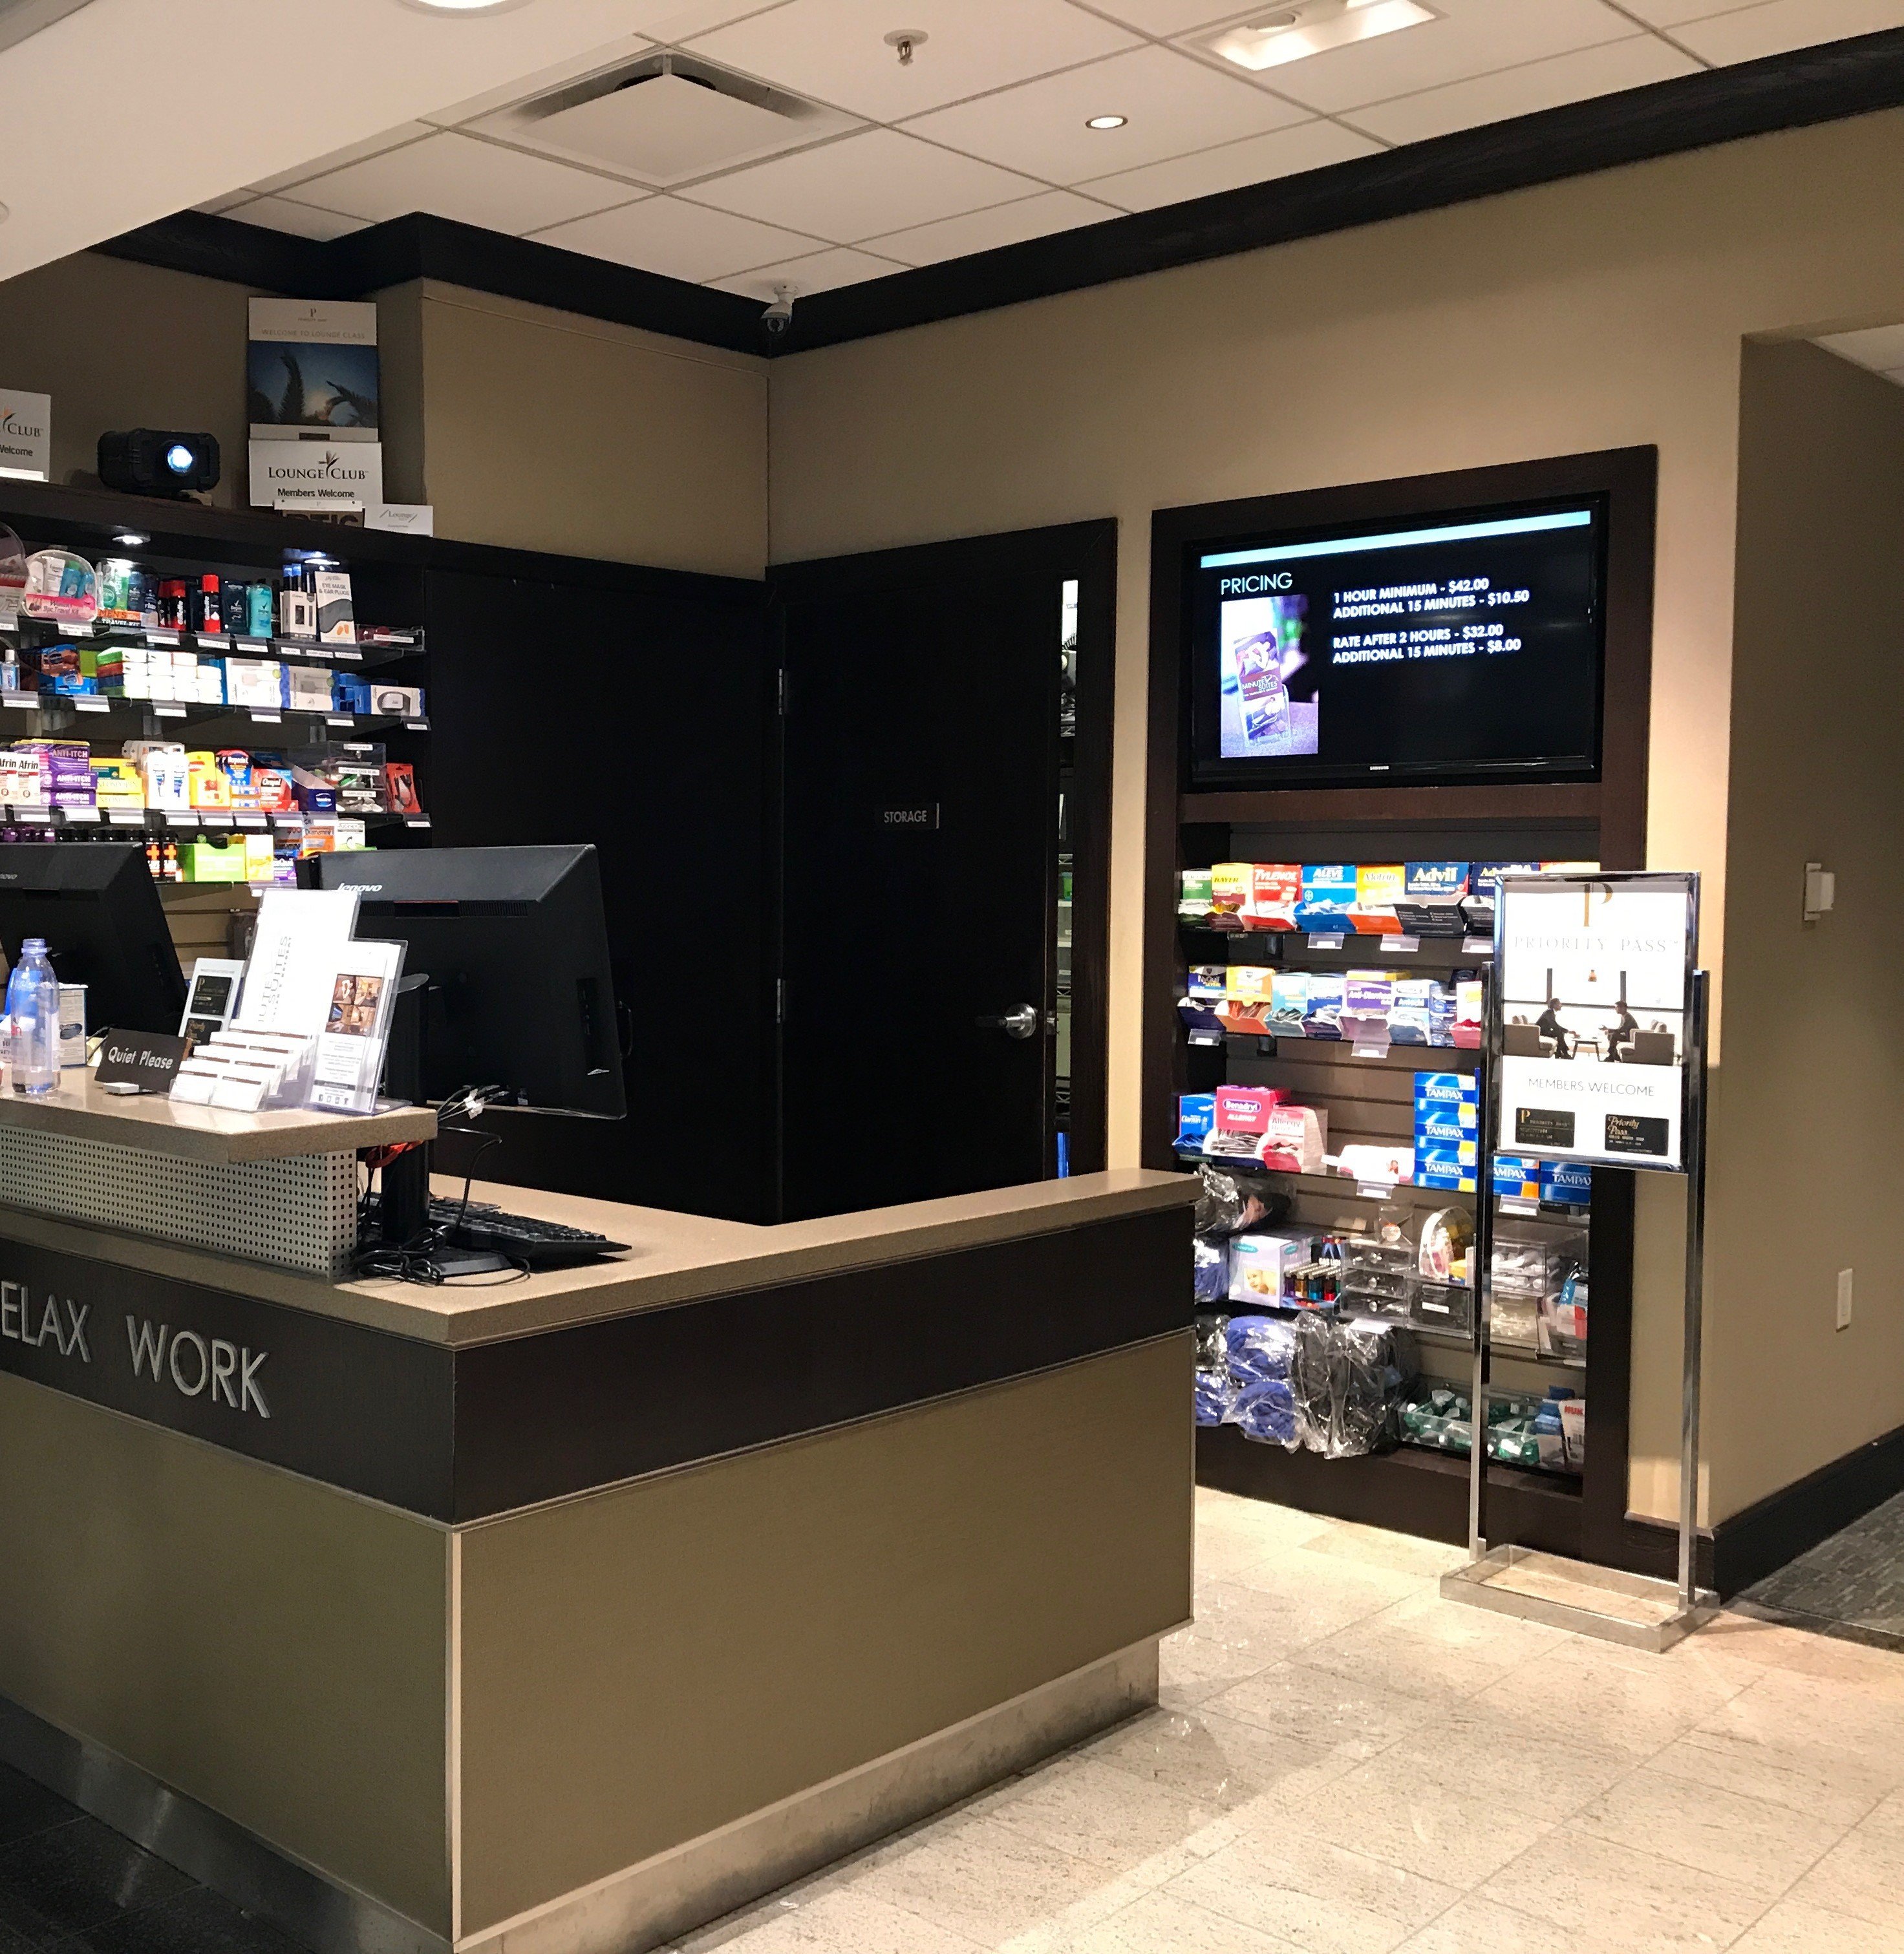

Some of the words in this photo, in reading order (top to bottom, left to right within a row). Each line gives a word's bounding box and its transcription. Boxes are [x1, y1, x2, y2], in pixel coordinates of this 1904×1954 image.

[261, 328, 297, 337] WELCOME
[7, 423, 41, 438] CLUB
[268, 466, 324, 480] LOUNGE
[331, 467, 366, 480] CLUB
[278, 488, 316, 498] Members
[317, 489, 355, 498] Welcome
[1220, 572, 1293, 595] PRICING
[1334, 593, 1340, 604] 1
[1343, 586, 1376, 602] HOUR
[1379, 583, 1437, 599] MINIMUM
[1448, 578, 1490, 595] $42.00
[1332, 602, 1405, 619] ADDITIONAL
[1407, 600, 1422, 612] 15
[1424, 595, 1476, 610] MINUTES
[1487, 589, 1530, 607] $10.50
[1333, 636, 1361, 649] RATE
[1363, 633, 1396, 646] AFTER
[1398, 632, 1407, 644] 2
[1409, 628, 1451, 642] HOURS
[1462, 624, 1504, 640] $32.00
[1332, 648, 1404, 664] ADDITIONAL
[1407, 646, 1422, 659] 15
[1424, 642, 1476, 657] MINUTES
[1487, 639, 1522, 655] $8.00
[1241, 677, 1267, 690] MINUTE
[1258, 681, 1278, 692] SUITES
[52, 749, 88, 758] ANTI-ITCH
[19, 760, 39, 770] Afrin
[56, 774, 91, 783] ANTI-ITCH
[55, 792, 90, 802] ANTI-ITCH
[884, 810, 927, 823] STORAGE
[1254, 868, 1298, 882] TYLENOL
[1365, 872, 1396, 882] Motrin
[1413, 867, 1459, 882] Advil
[337, 882, 383, 893] lenovo
[1583, 882, 1613, 927] P
[1514, 935, 1607, 950] PRIORITY
[107, 1046, 136, 1064] Quiet
[139, 1050, 173, 1070] Please
[1424, 1087, 1464, 1100] TAMPAX
[1528, 1078, 1584, 1092] MEMBERS
[1588, 1082, 1654, 1097] WELCOME
[1226, 1101, 1259, 1112] Benadryl
[1226, 1114, 1257, 1122] ALLERGY
[1272, 1117, 1301, 1128] Allergy
[1607, 1115, 1640, 1130] Priority
[1424, 1125, 1464, 1138] TAMPAX
[1424, 1163, 1464, 1176] TAMPAX
[125, 1314, 272, 1419] WORK
